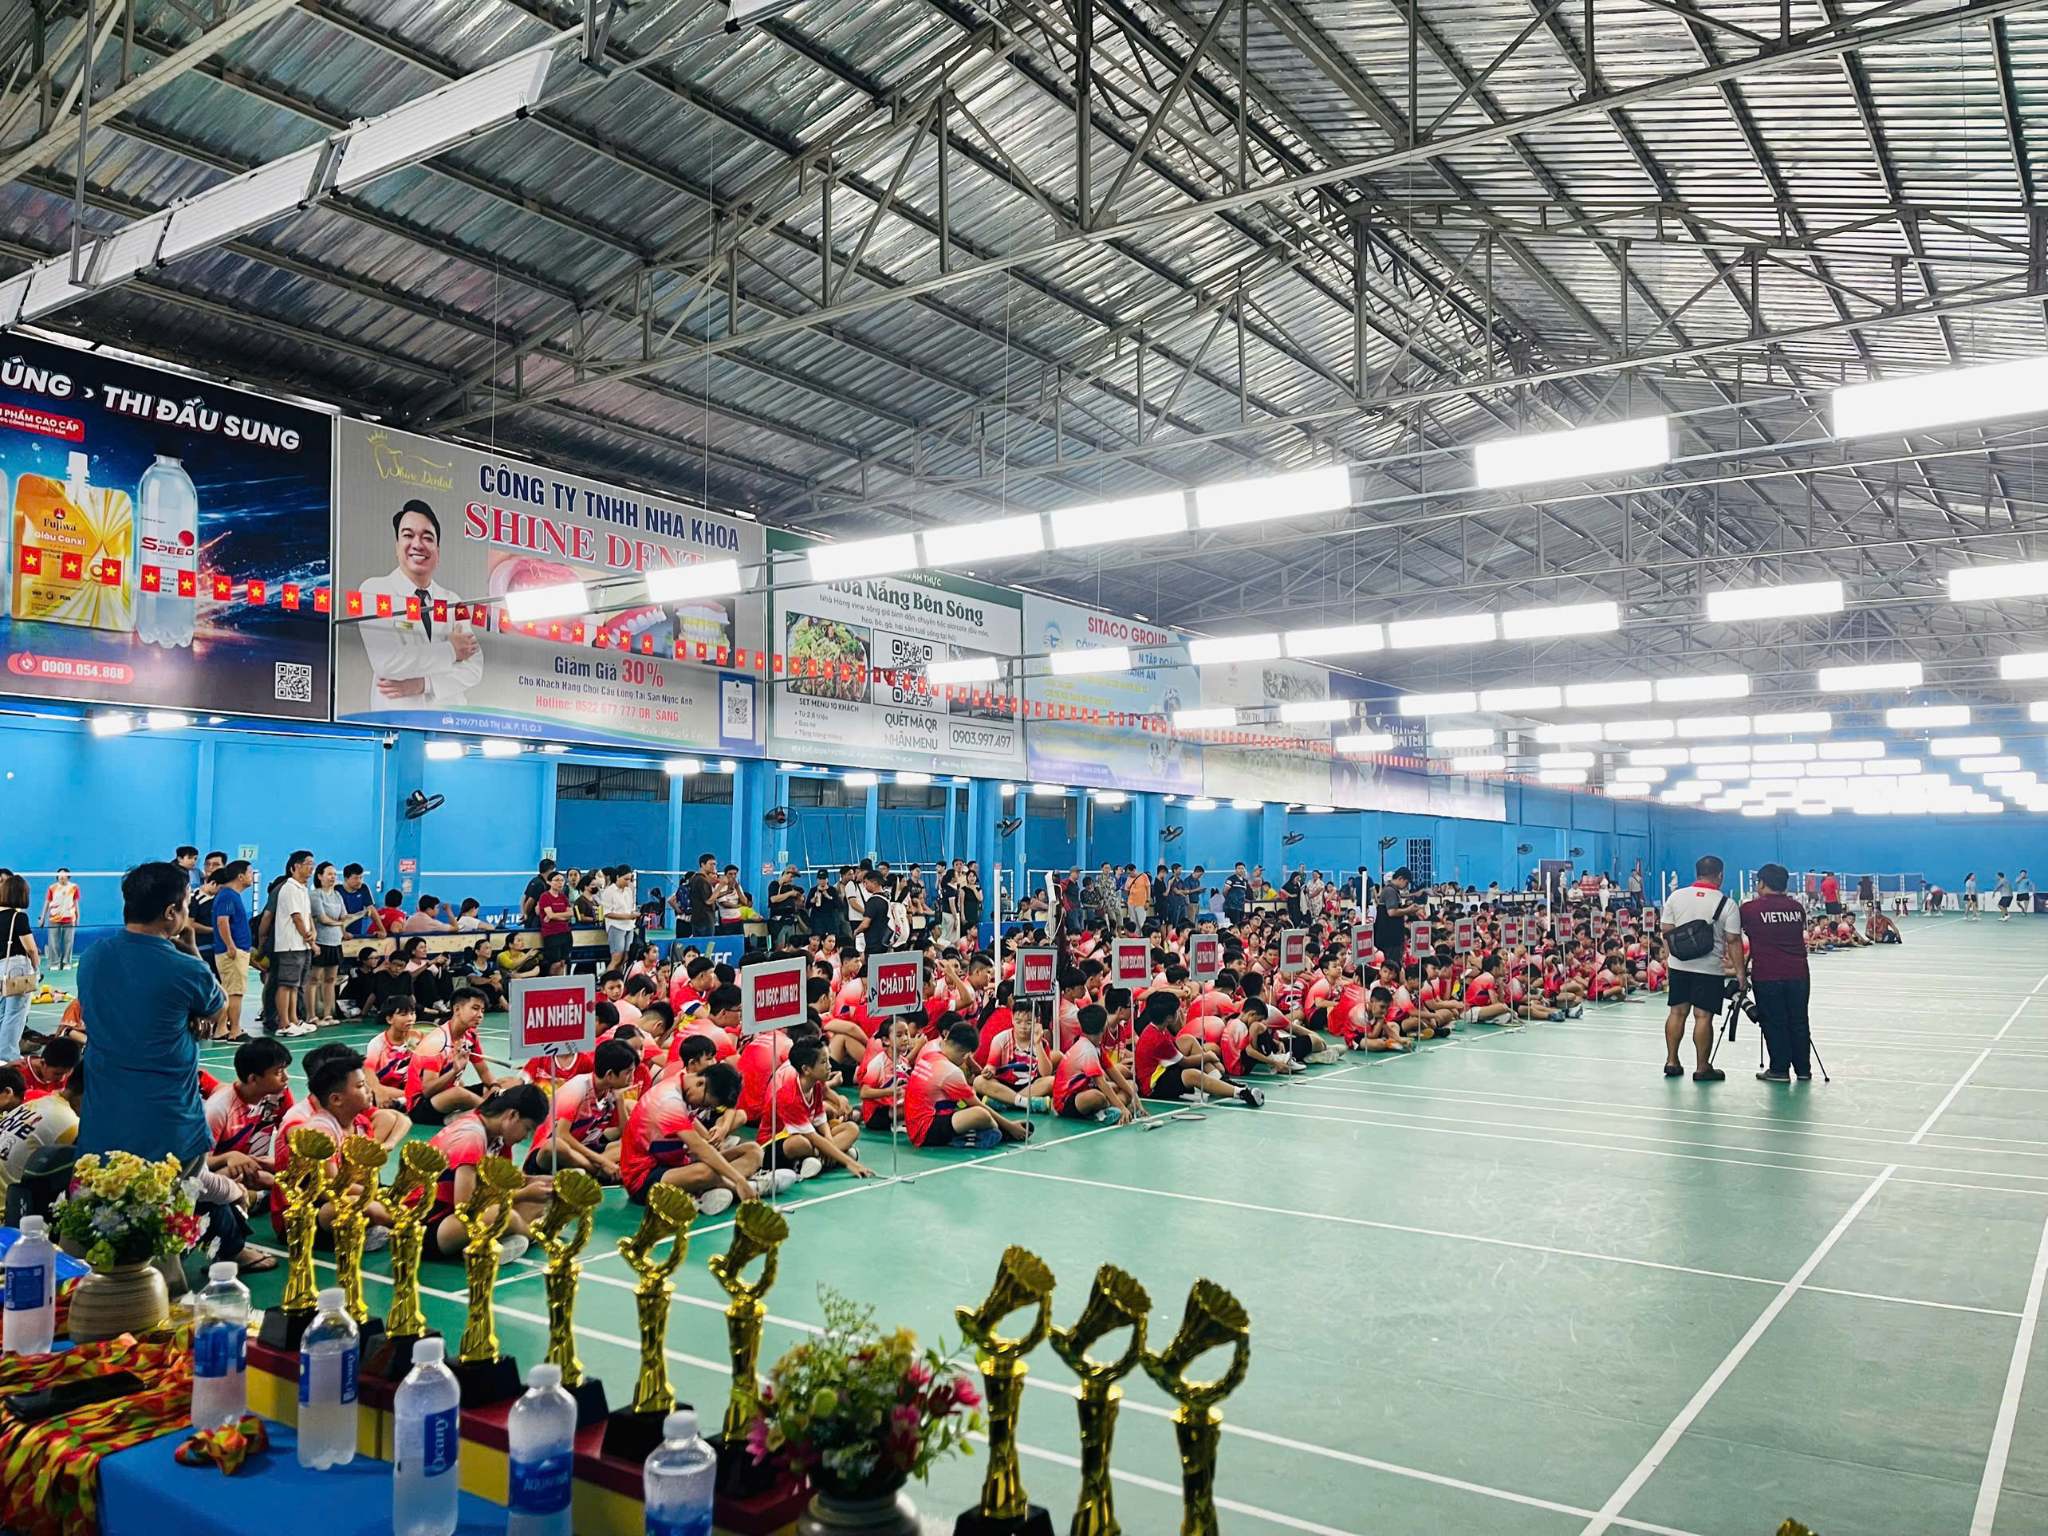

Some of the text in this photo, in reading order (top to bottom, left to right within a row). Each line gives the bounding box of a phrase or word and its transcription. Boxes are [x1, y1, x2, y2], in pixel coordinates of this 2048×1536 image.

[35, 416, 57, 428] CAO
[103, 384, 153, 418] THI
[156, 396, 220, 432] ĐẤU
[223, 416, 301, 451] SUNG
[480, 461, 740, 553] CÔNG TY TNHH NHA KHOA
[141, 536, 195, 556] SPEED
[464, 500, 707, 574] SHINE DENT
[867, 580, 910, 611] Nắng
[913, 591, 943, 615] Bên
[946, 599, 984, 627] Sông
[1087, 615, 1128, 640] SITACO
[554, 654, 664, 689] Giảm Giá 30%
[923, 717, 938, 734] QR
[912, 734, 939, 751] MENU
[1760, 911, 1802, 924] VIETNAM
[879, 972, 904, 996] CHÂU
[526, 997, 583, 1029] AN NHIÊN
